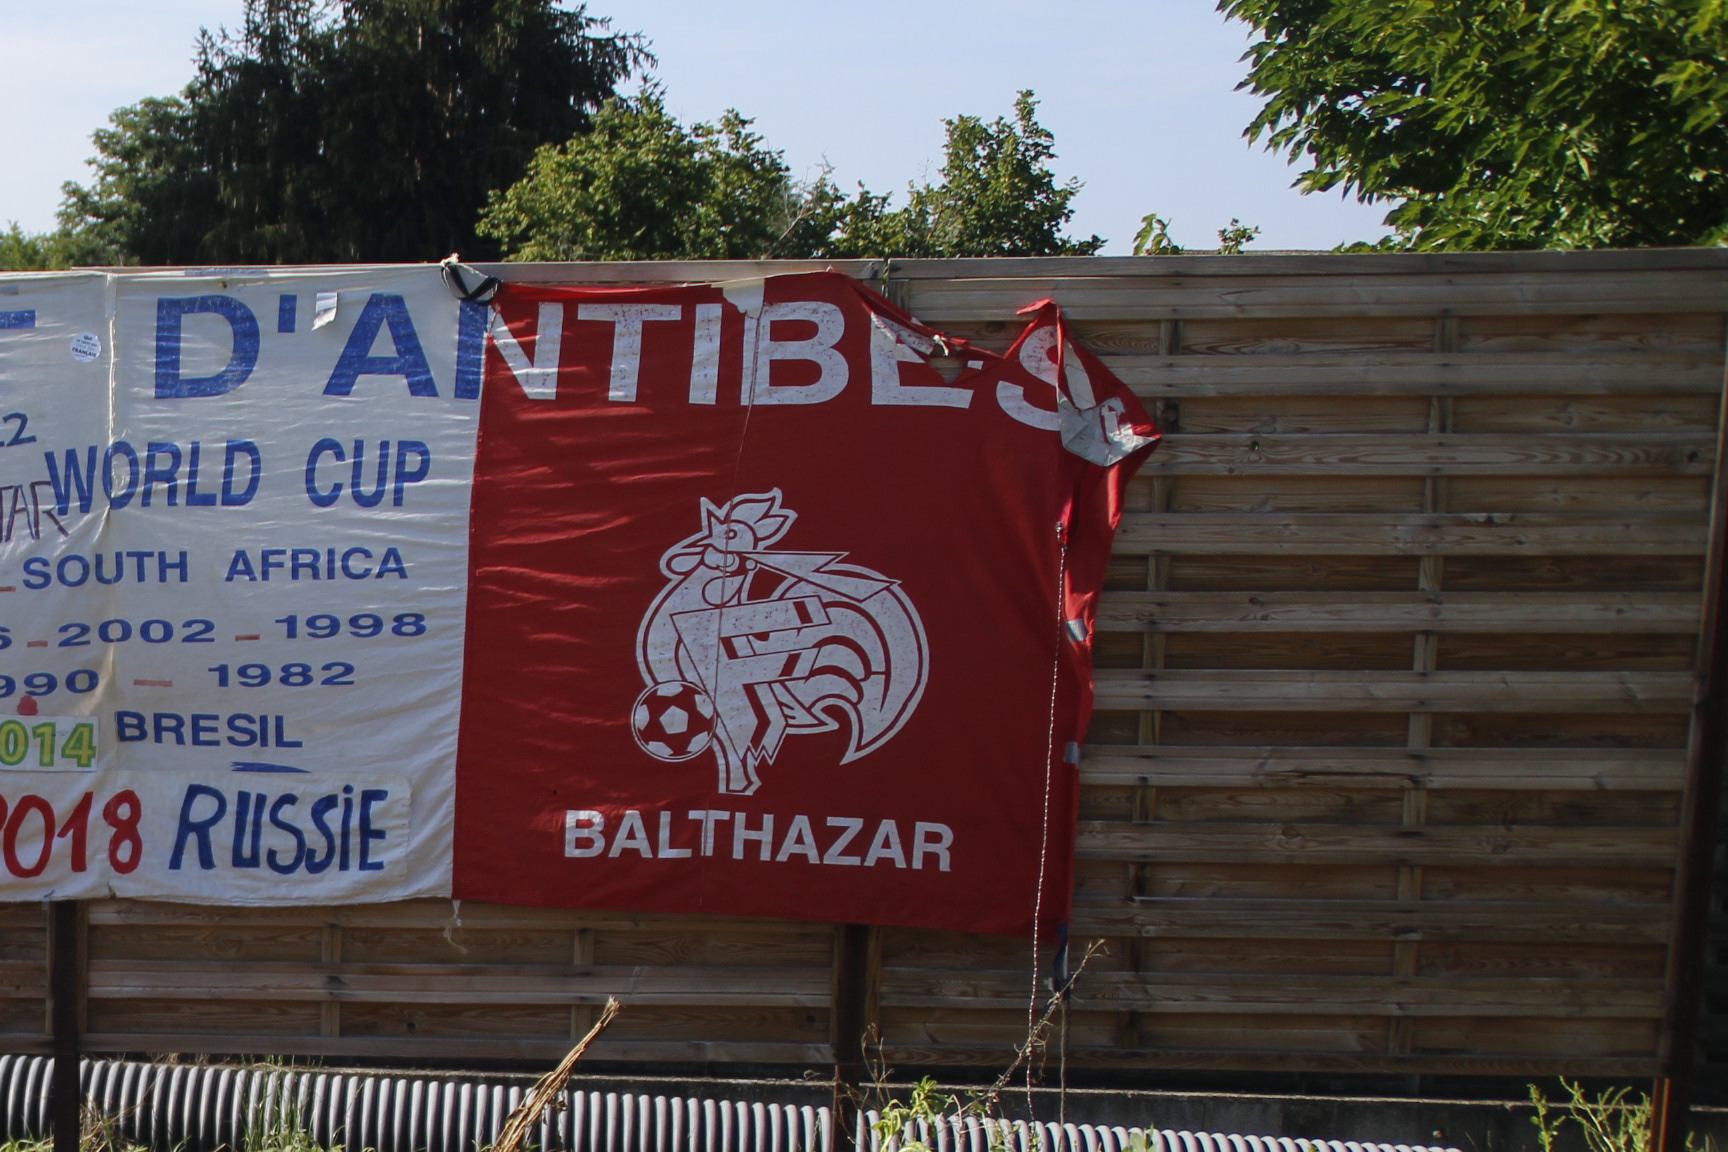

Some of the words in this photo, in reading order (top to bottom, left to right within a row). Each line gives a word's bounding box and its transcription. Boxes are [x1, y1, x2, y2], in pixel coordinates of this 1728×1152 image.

[44, 439, 261, 516] WORLD
[304, 437, 432, 508] CUP
[22, 549, 188, 588] SOUTH
[224, 546, 409, 583] AFRICA
[57, 618, 216, 647] 2002
[274, 612, 428, 639] 1998
[207, 661, 356, 688] 1982
[115, 709, 304, 748] BRESIL
[563, 809, 955, 873] BALTHAZAR
